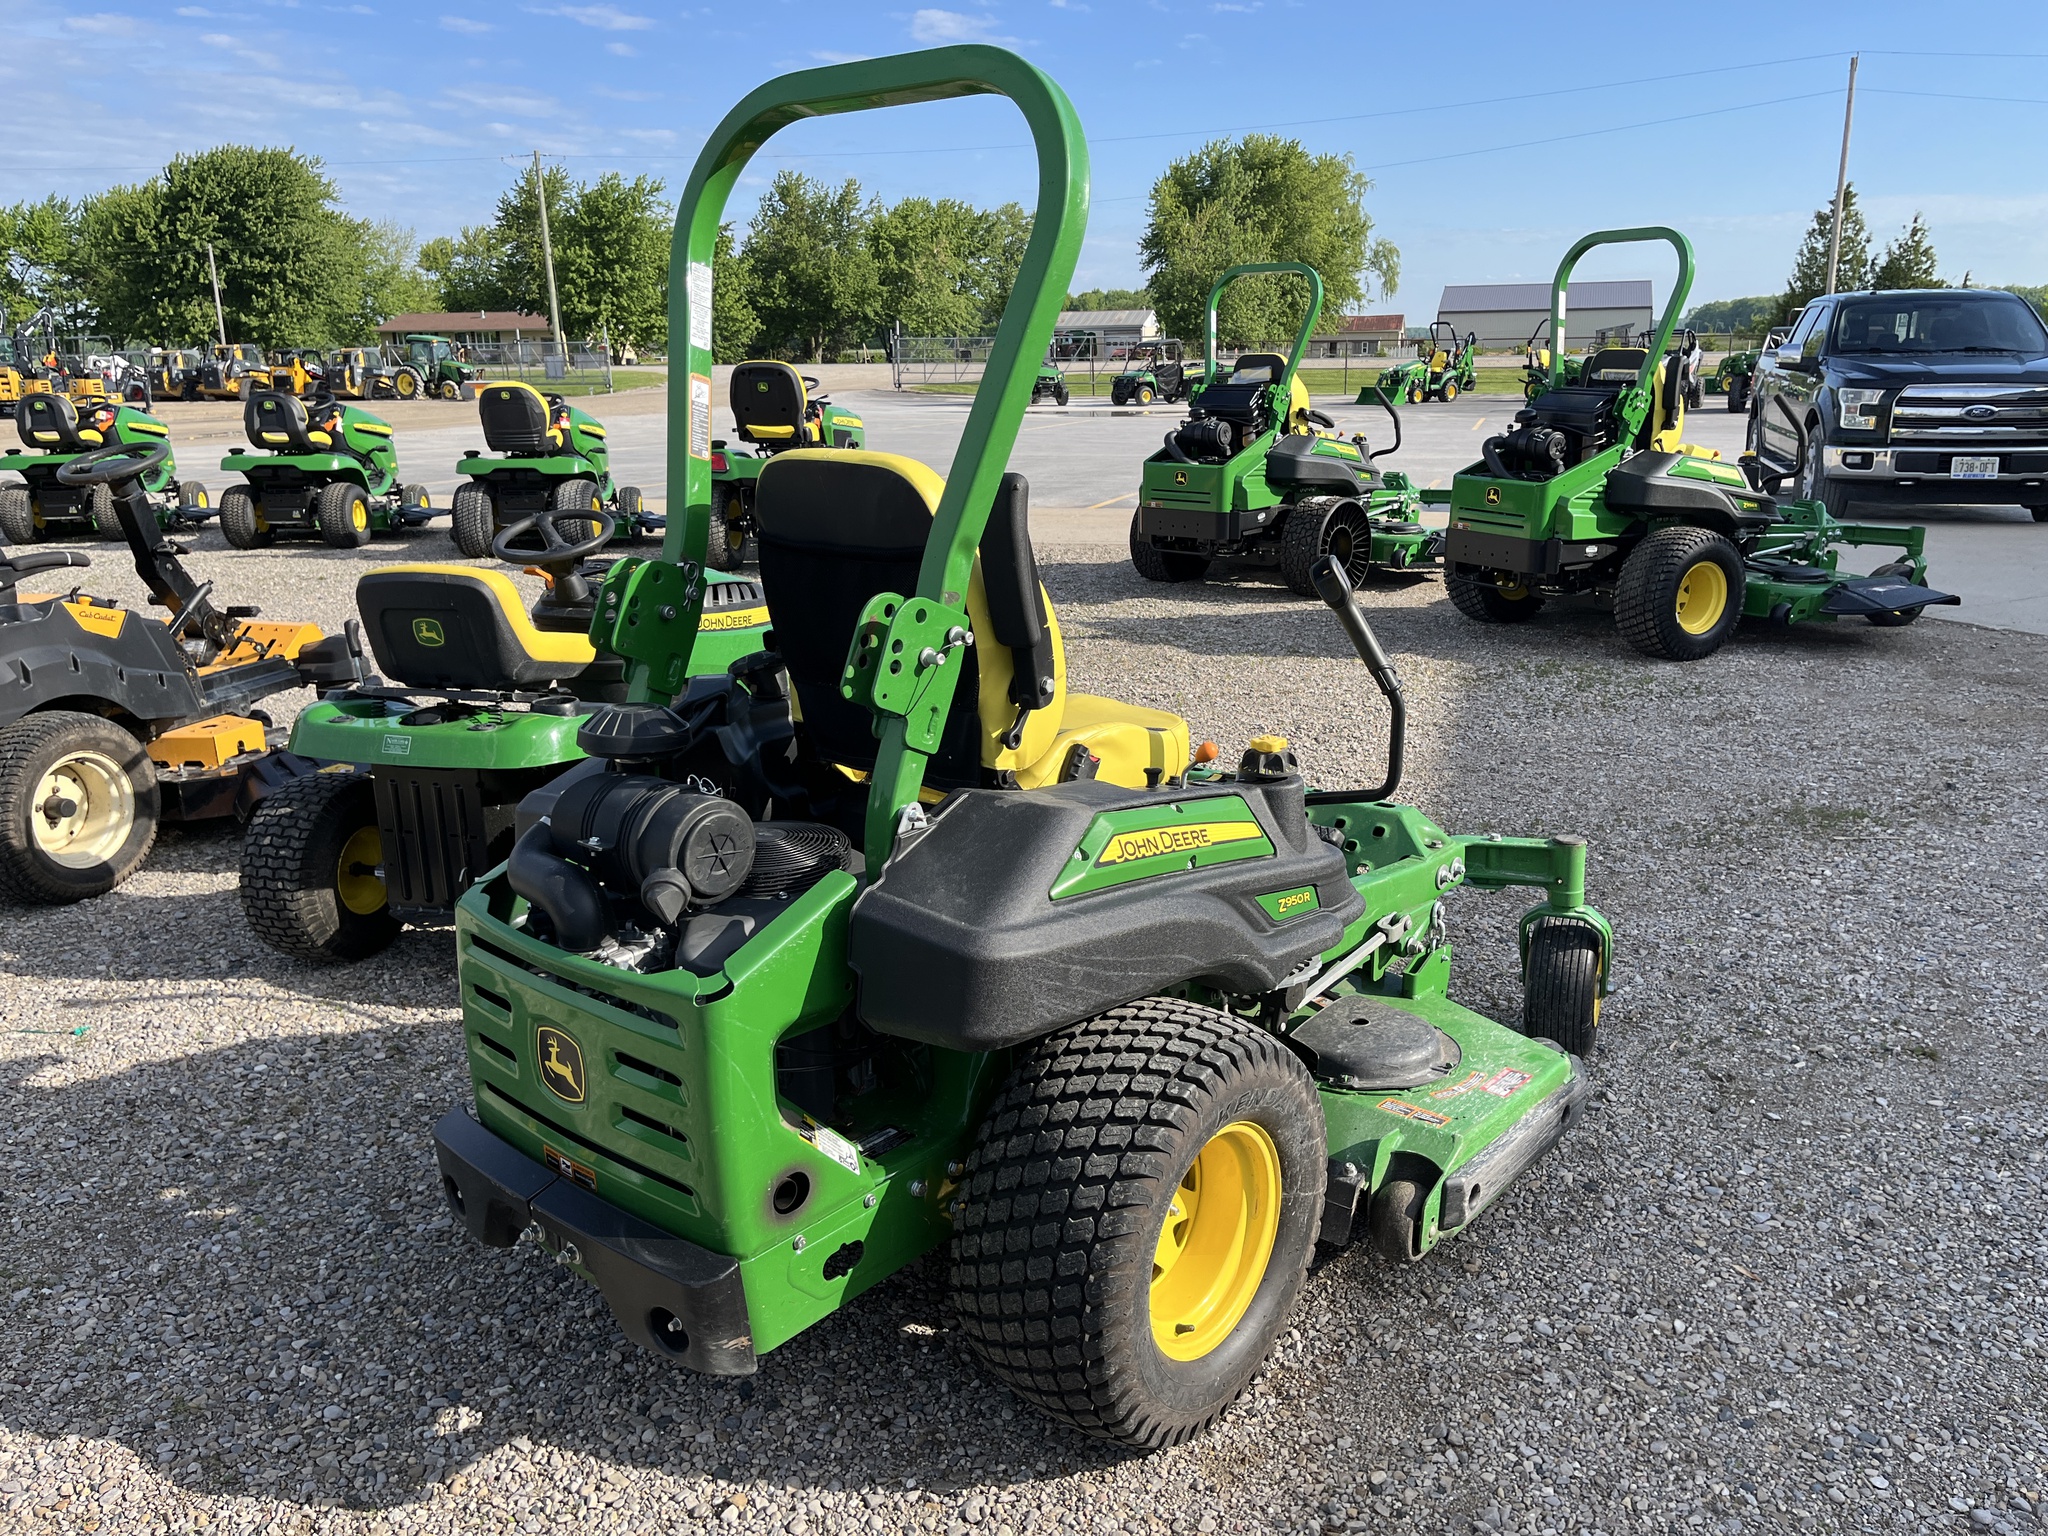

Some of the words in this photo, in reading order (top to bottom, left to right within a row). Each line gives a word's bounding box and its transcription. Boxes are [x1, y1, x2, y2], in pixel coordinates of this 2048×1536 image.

[1959, 462, 1975, 473] 738
[79, 610, 93, 618] Cub
[93, 612, 116, 621] Cadet
[699, 618, 725, 629] JOHN
[725, 615, 752, 627] DEERE
[1116, 837, 1159, 860] JOHN
[1158, 828, 1210, 850] DEERE
